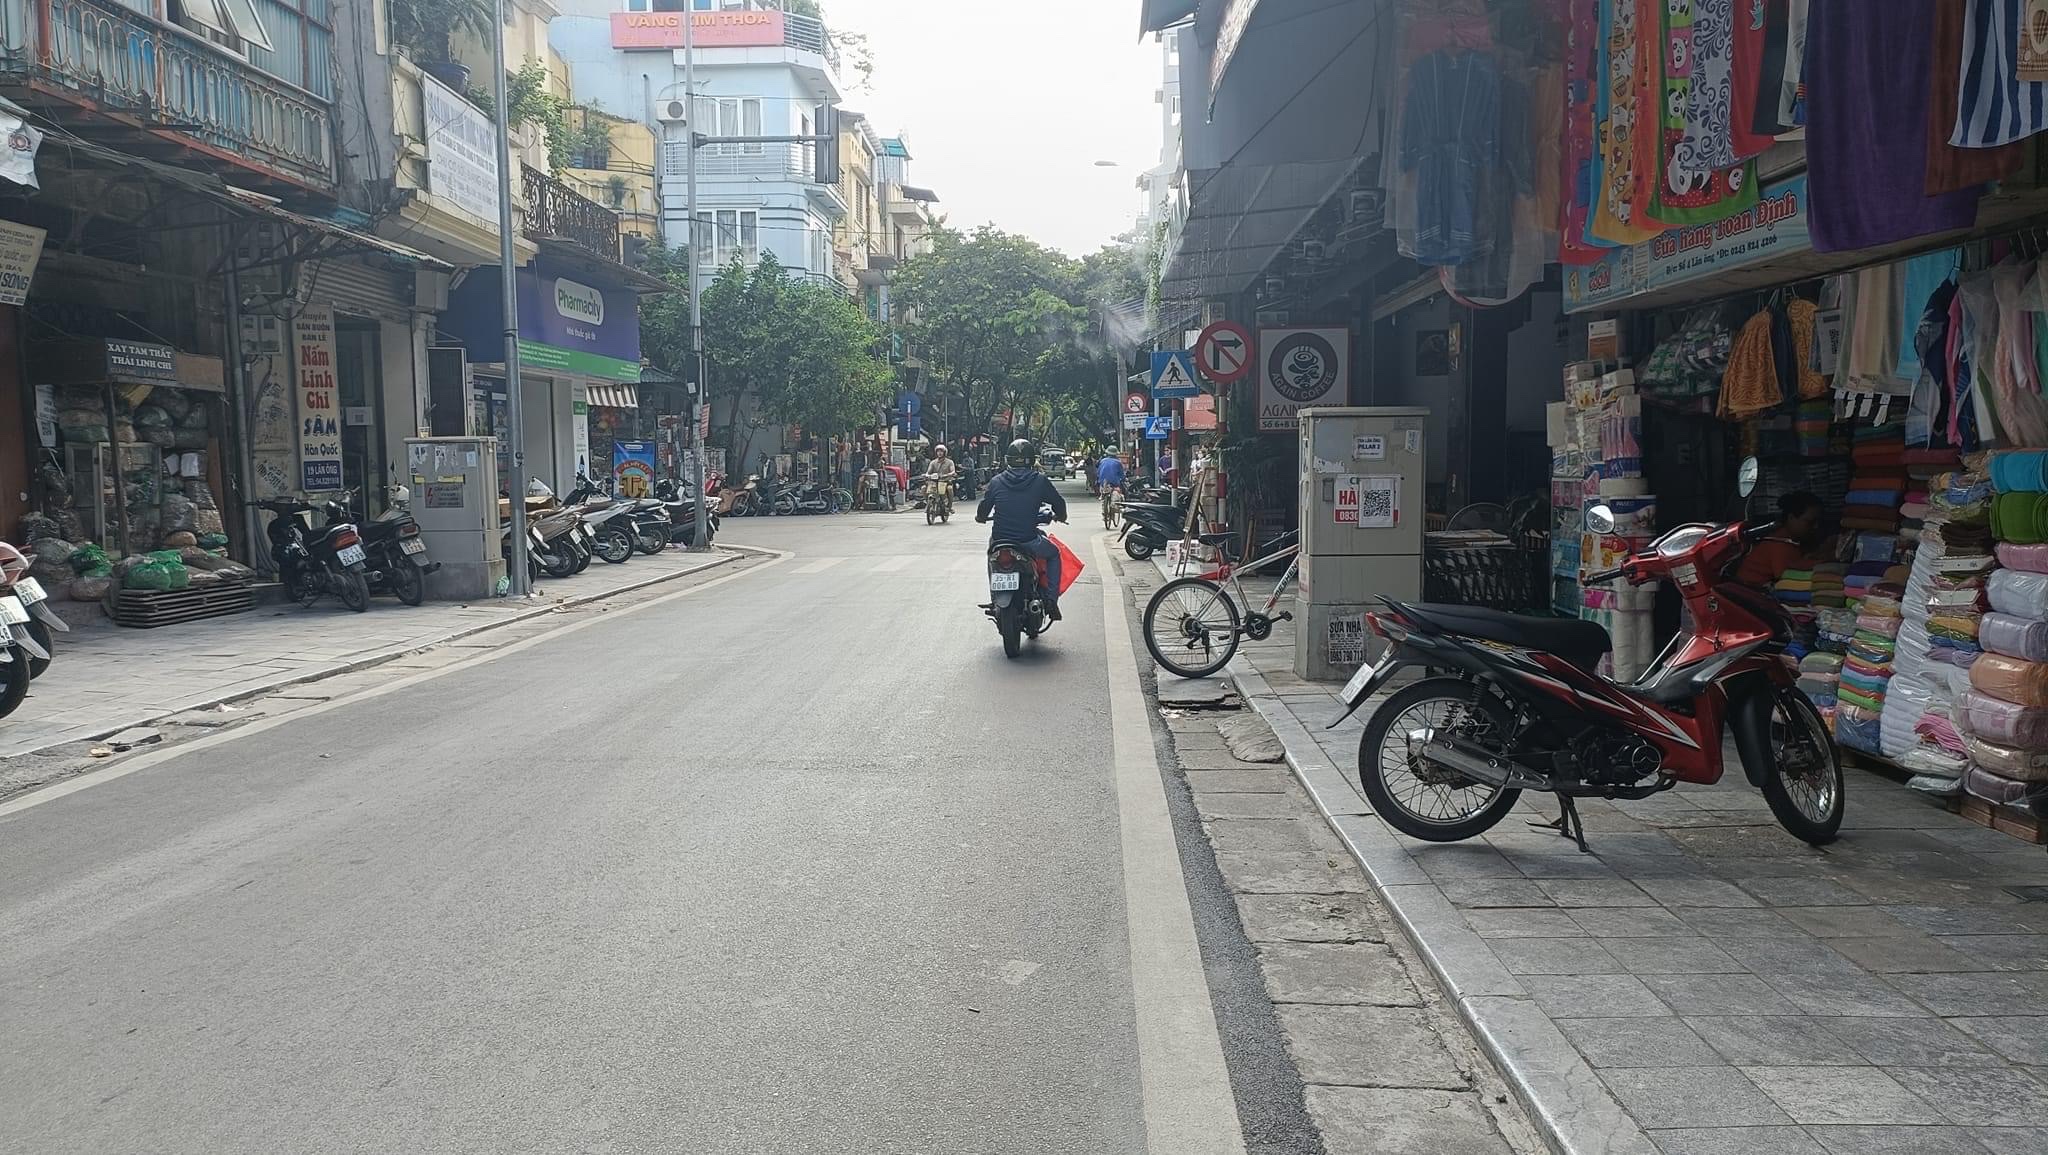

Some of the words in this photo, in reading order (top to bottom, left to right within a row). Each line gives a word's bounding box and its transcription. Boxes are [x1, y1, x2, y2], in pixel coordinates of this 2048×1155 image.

[625, 13, 679, 28] VÀNG
[721, 14, 772, 26] THOA
[1755, 189, 1797, 230] Định
[558, 288, 601, 322] Pharmacity
[107, 343, 128, 353] XAY
[129, 346, 148, 356] TAM
[301, 345, 329, 366] Nấm
[136, 359, 157, 369] LINH
[157, 361, 172, 370] CHI
[301, 369, 333, 388] Linh
[1271, 373, 1297, 398] AGAIN
[1301, 371, 1334, 399] COFFEE
[306, 391, 330, 409] Chi
[304, 413, 338, 436] SÂM
[304, 443, 318, 456] Hàn
[320, 441, 338, 457] Quốc
[1330, 617, 1345, 633] SỬA
[1346, 617, 1362, 633] NHÀ
